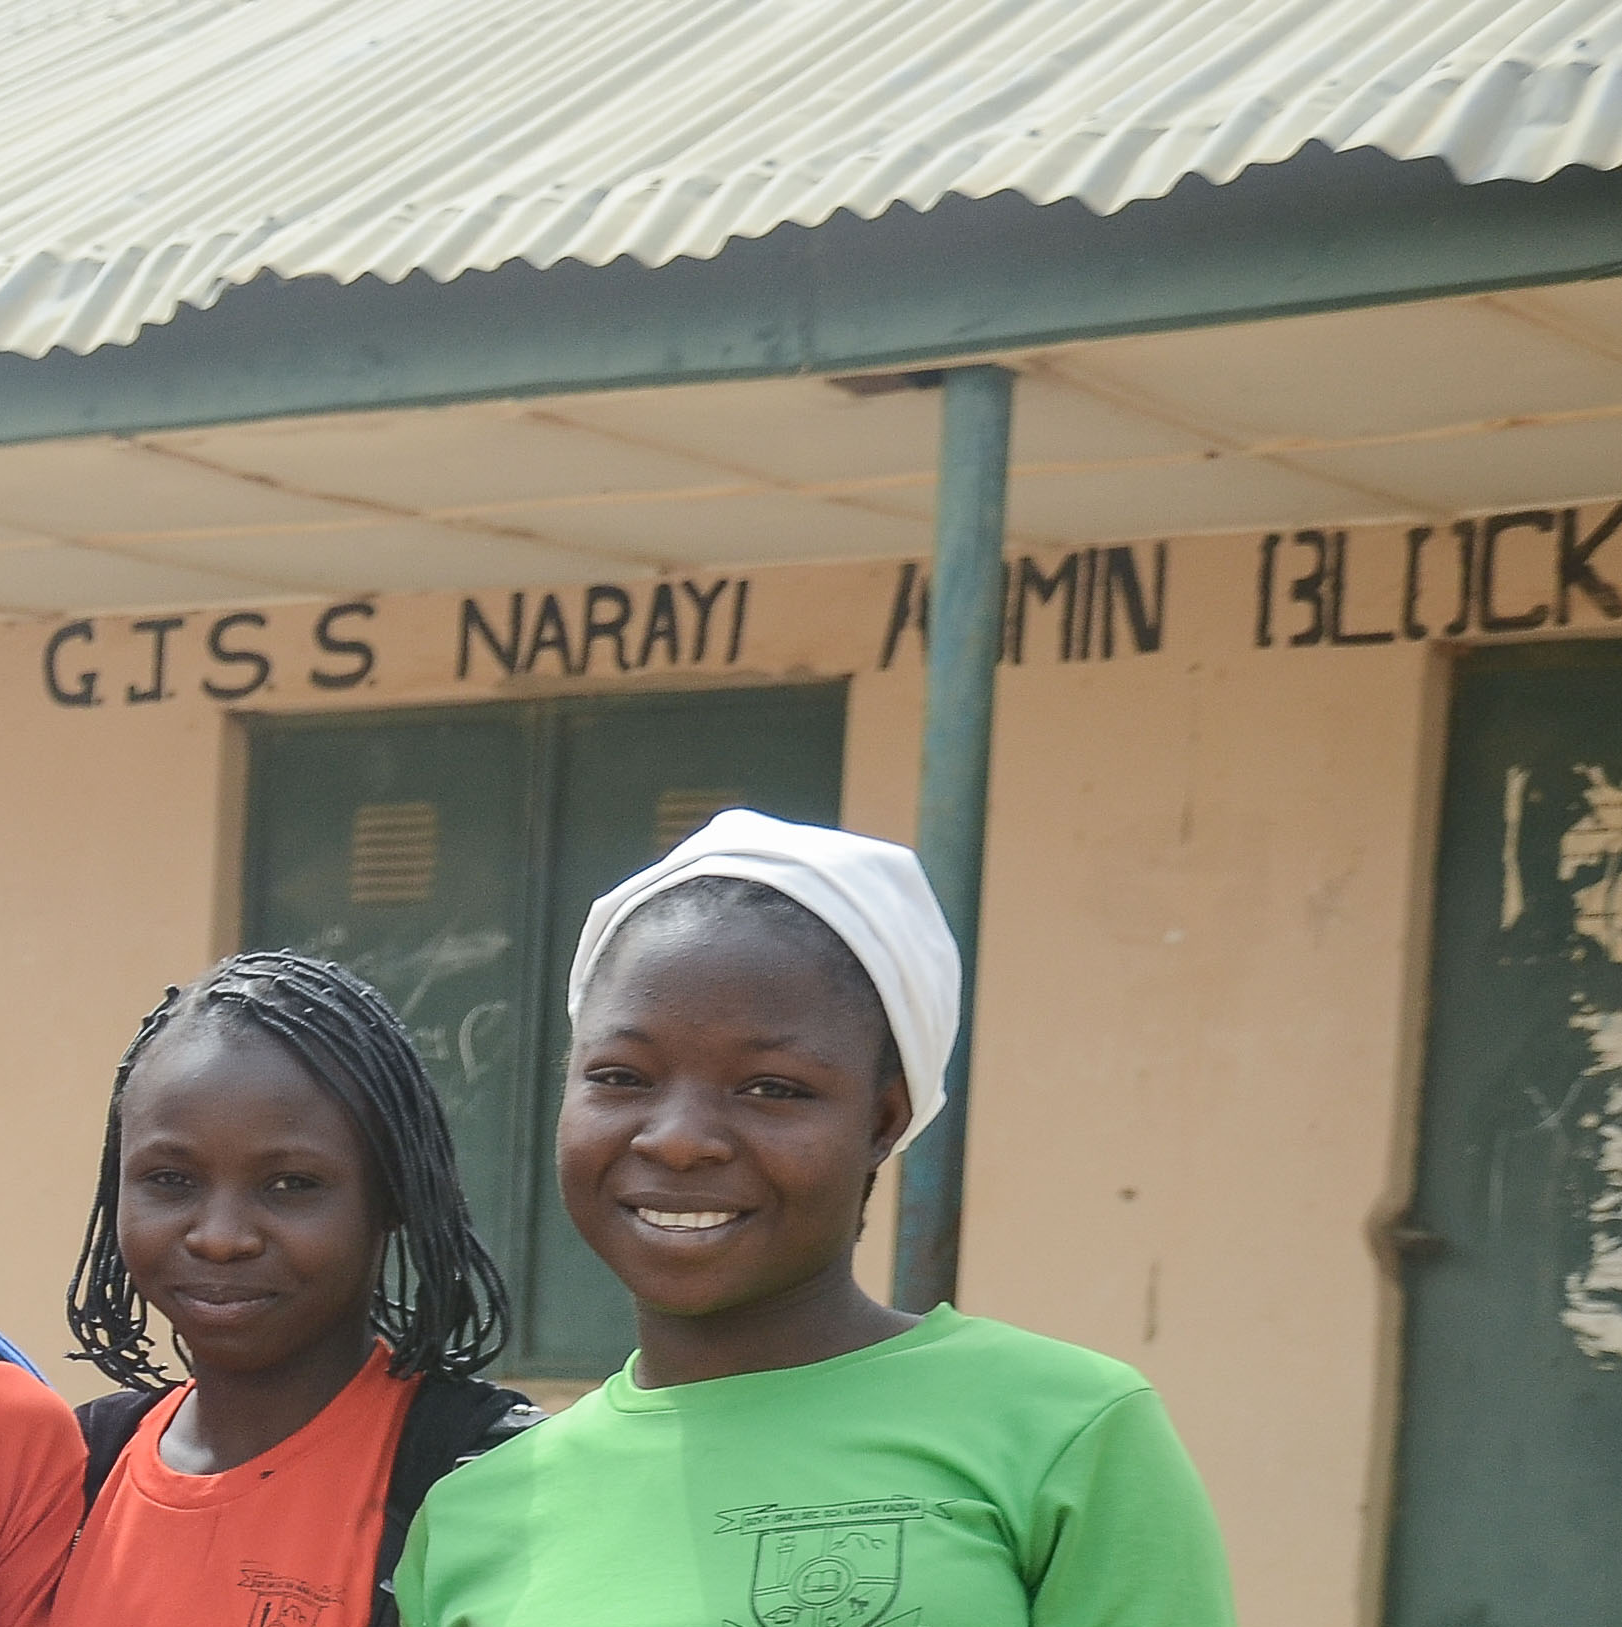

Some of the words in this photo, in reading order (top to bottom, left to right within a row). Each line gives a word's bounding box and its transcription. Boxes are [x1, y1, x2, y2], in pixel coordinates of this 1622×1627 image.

[457, 578, 749, 679] NARAYI
[878, 540, 1167, 672] AMIN
[1256, 502, 1622, 647] BLOCK
